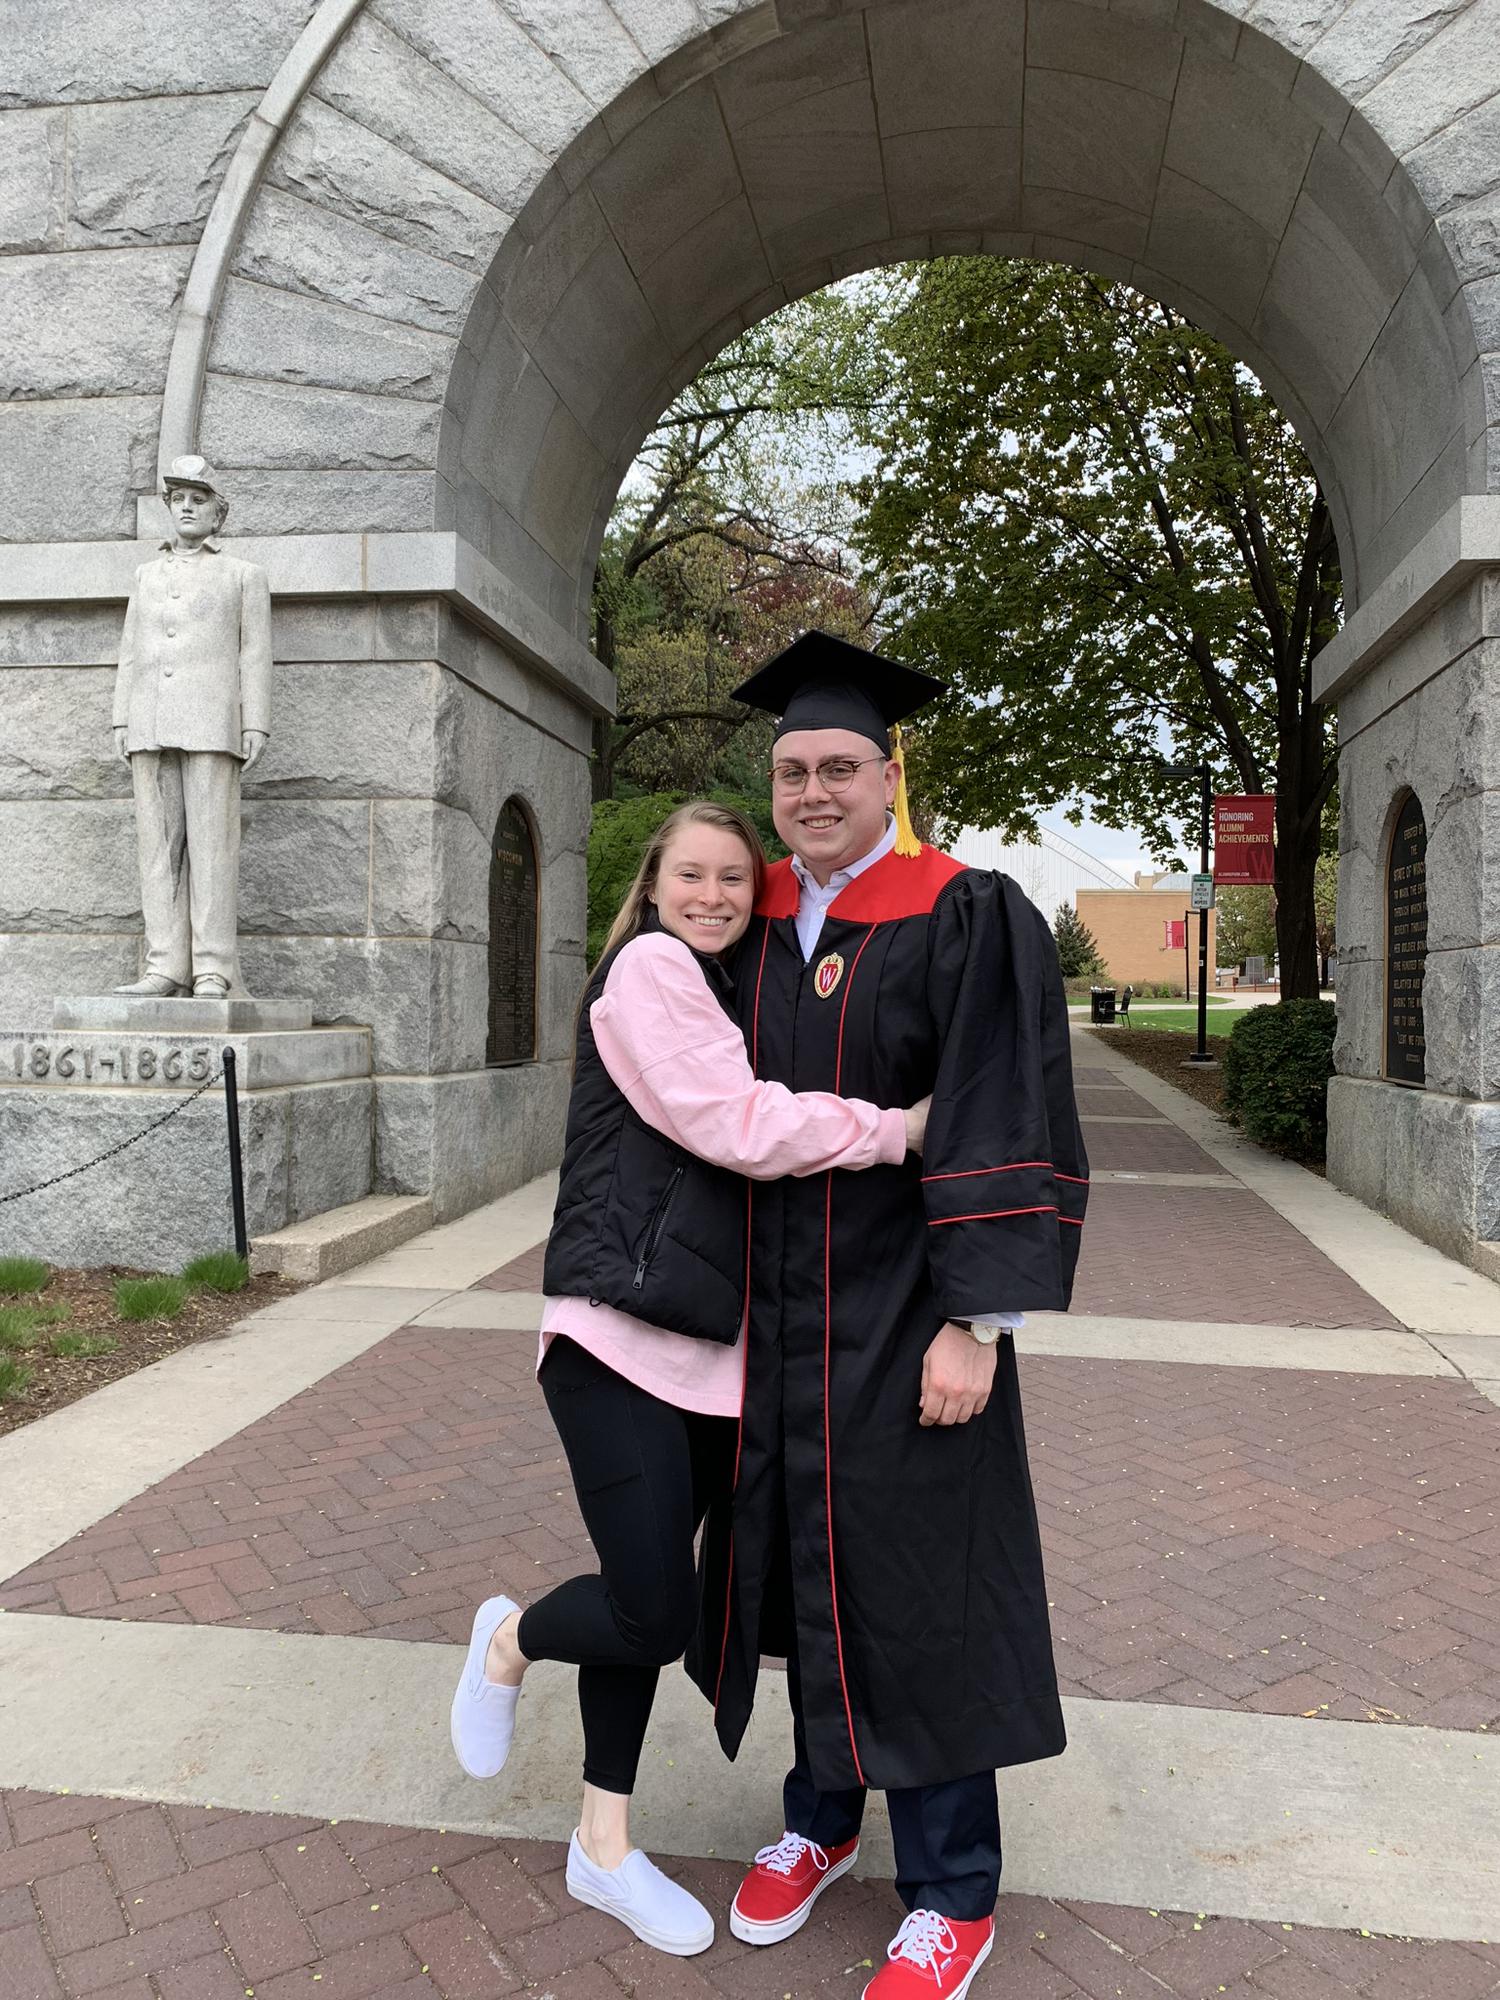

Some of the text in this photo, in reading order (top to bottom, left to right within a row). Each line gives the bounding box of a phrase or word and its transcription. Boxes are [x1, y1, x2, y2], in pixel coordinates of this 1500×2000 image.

[1218, 812, 1254, 821] HONORING
[1218, 823, 1245, 833] ALUMNI
[1218, 834, 1270, 843] ACHIEVEMENTS
[822, 967, 837, 989] W
[12, 1042, 211, 1081] 1861-1865
